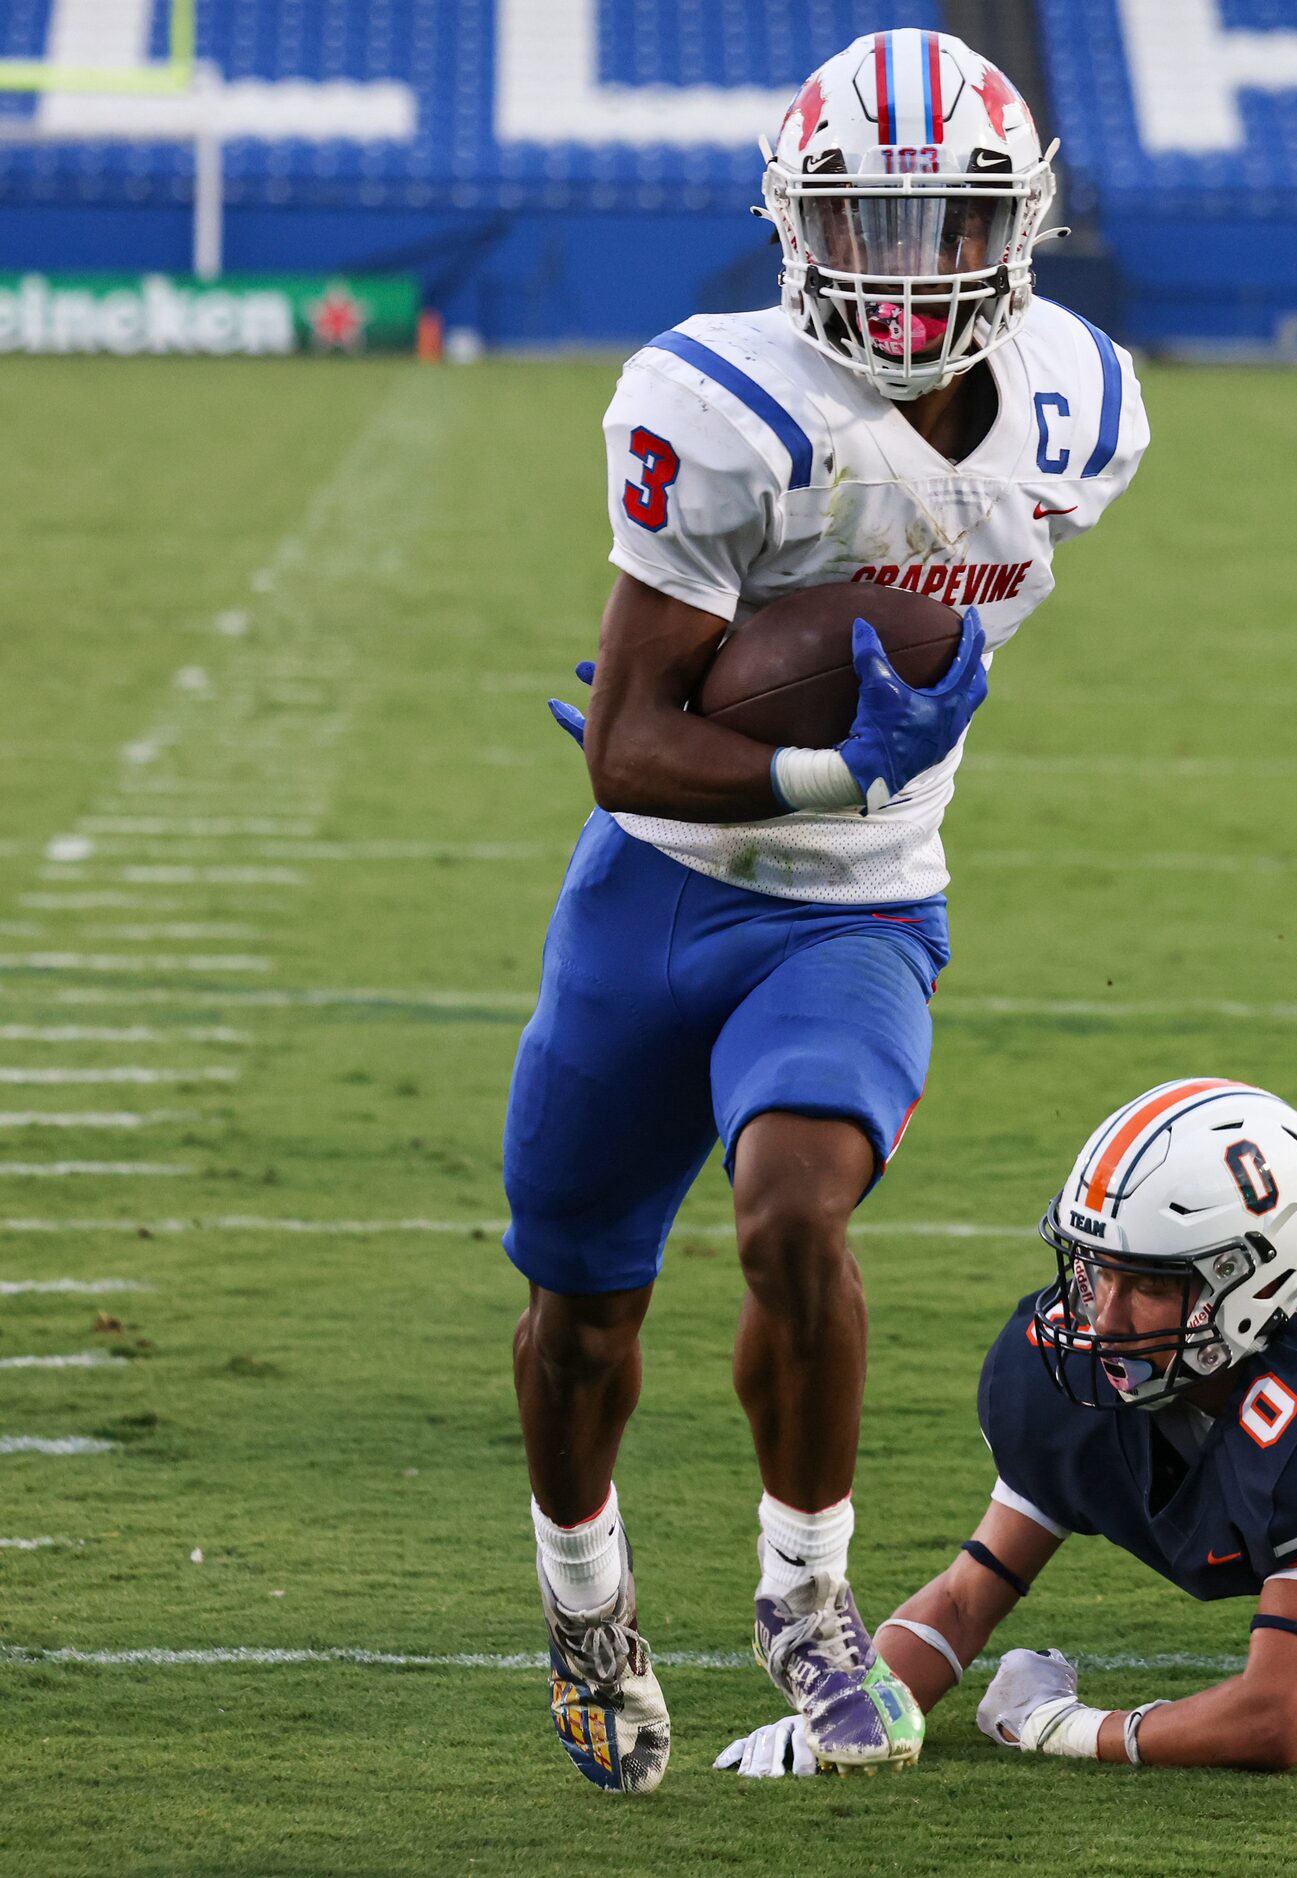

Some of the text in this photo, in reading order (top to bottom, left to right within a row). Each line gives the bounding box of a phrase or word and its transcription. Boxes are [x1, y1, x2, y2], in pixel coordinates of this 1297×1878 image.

[1033, 392, 1071, 474] C
[622, 425, 680, 533] 3
[1070, 1210, 1107, 1239] TEAM
[1073, 1258, 1095, 1303] ddell
